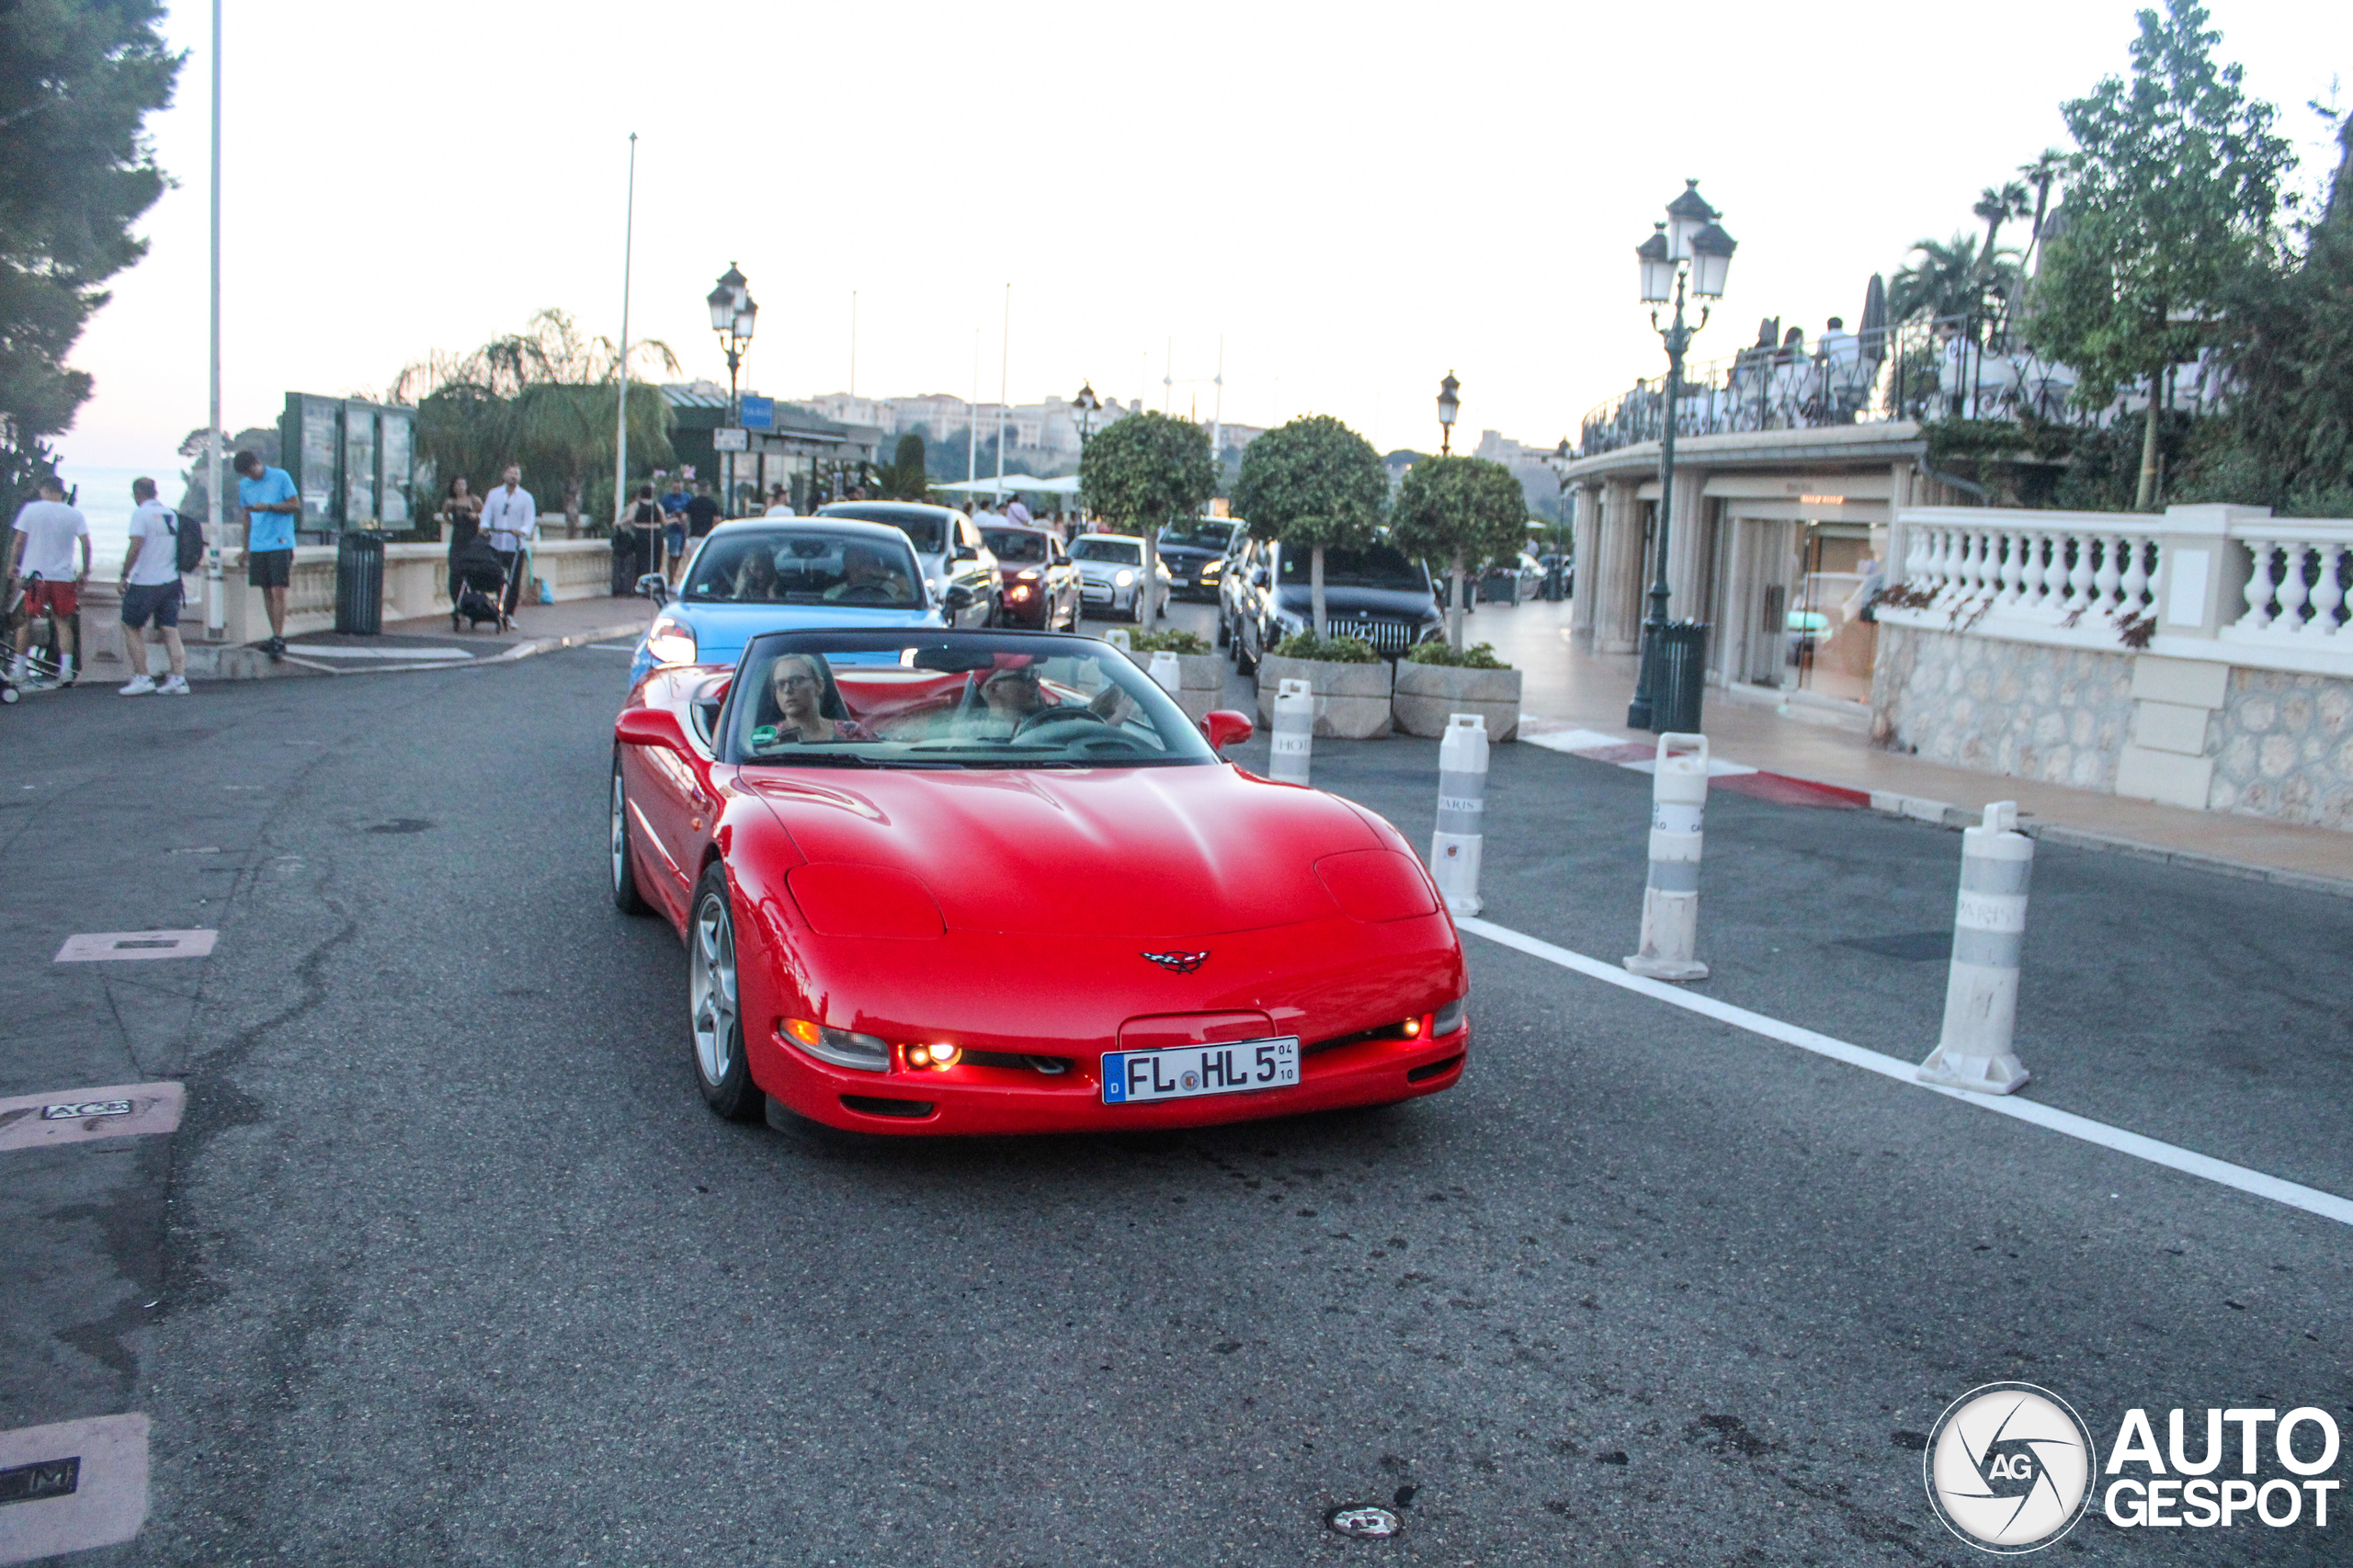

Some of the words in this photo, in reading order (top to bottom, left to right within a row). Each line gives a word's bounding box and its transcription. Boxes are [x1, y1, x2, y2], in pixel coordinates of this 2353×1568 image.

[1278, 1043, 1292, 1055] 04
[1110, 1083, 1120, 1094] D
[1127, 1056, 1176, 1095] FL
[1201, 1050, 1247, 1088] HL
[1256, 1045, 1276, 1082] 5
[1280, 1069, 1293, 1080] 10
